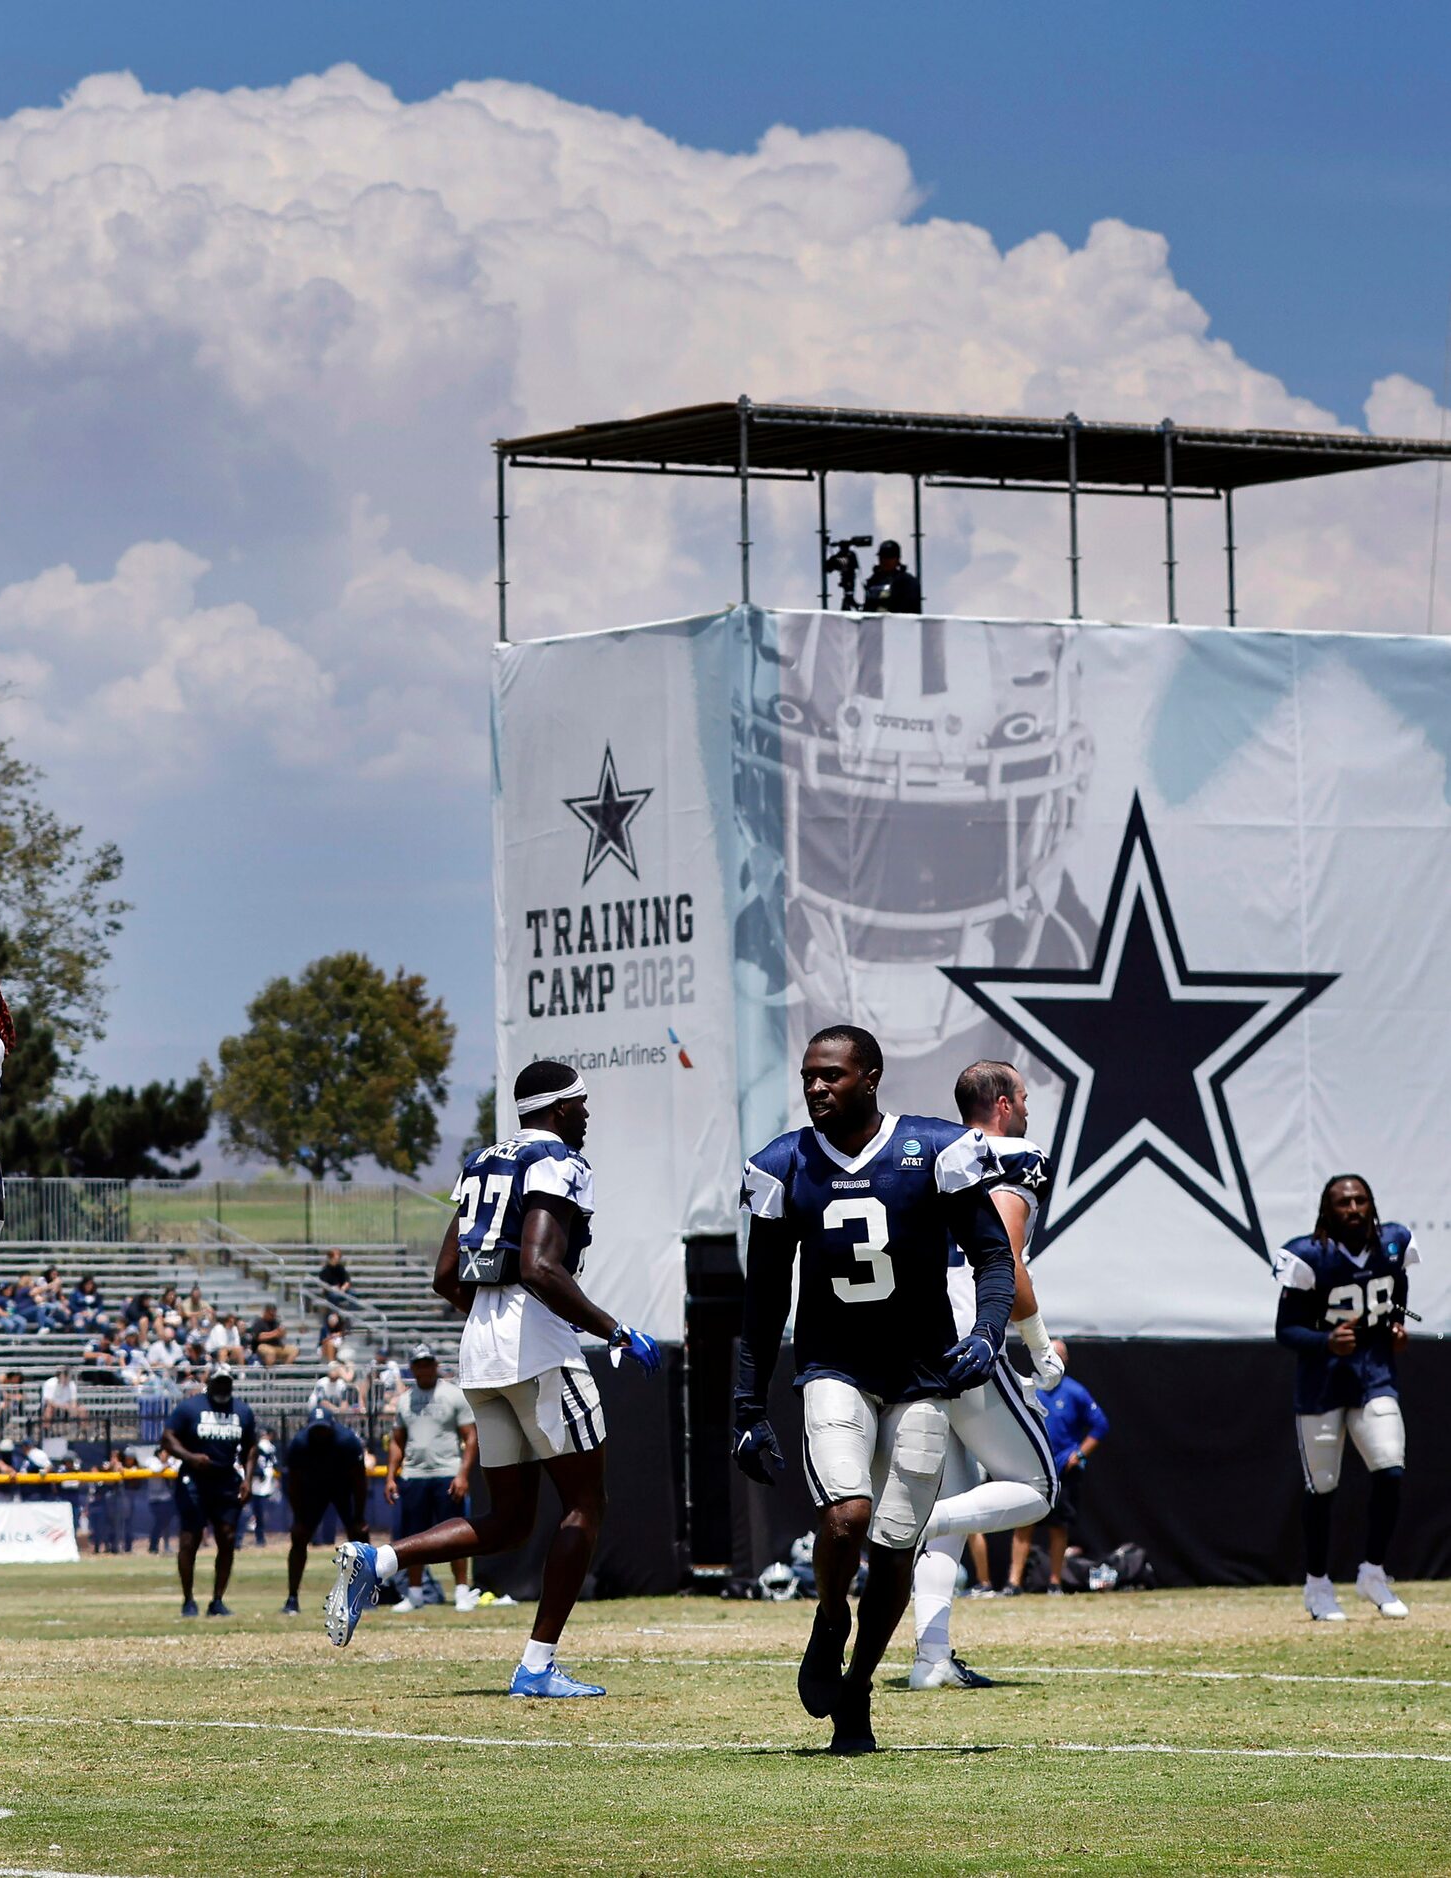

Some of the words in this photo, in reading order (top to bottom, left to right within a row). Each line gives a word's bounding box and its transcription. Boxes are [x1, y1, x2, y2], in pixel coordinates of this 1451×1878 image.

[526, 893, 694, 959] TRAINING
[528, 962, 615, 1019] CAMP
[623, 953, 696, 1010] 2022
[608, 1043, 668, 1069] Airlines
[900, 1157, 924, 1167] AT&T
[458, 1173, 514, 1253] 27
[822, 1196, 896, 1303] 3
[1324, 1275, 1395, 1328] 28
